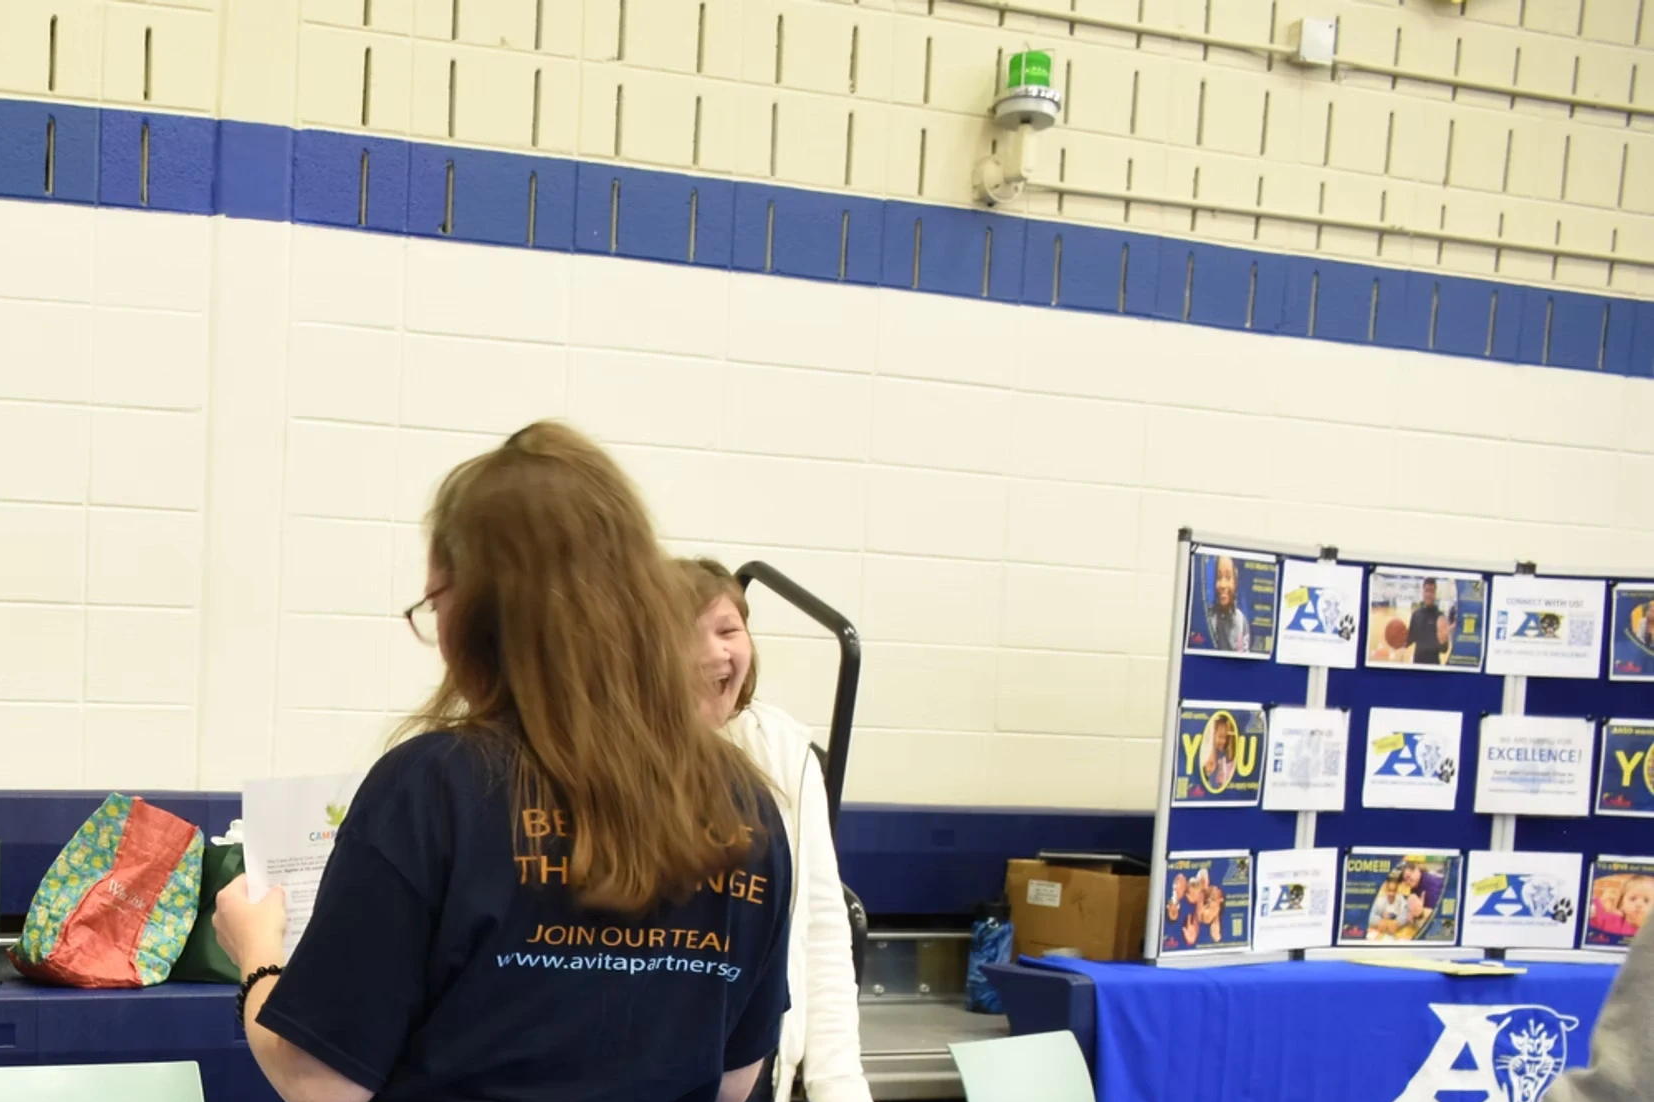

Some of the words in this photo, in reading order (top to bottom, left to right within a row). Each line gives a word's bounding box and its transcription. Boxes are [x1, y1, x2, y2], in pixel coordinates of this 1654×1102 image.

[1486, 746, 1583, 764] EXCELLENCE!
[513, 855, 568, 884] TH
[526, 923, 595, 946] JOIN
[600, 926, 666, 948] OUR
